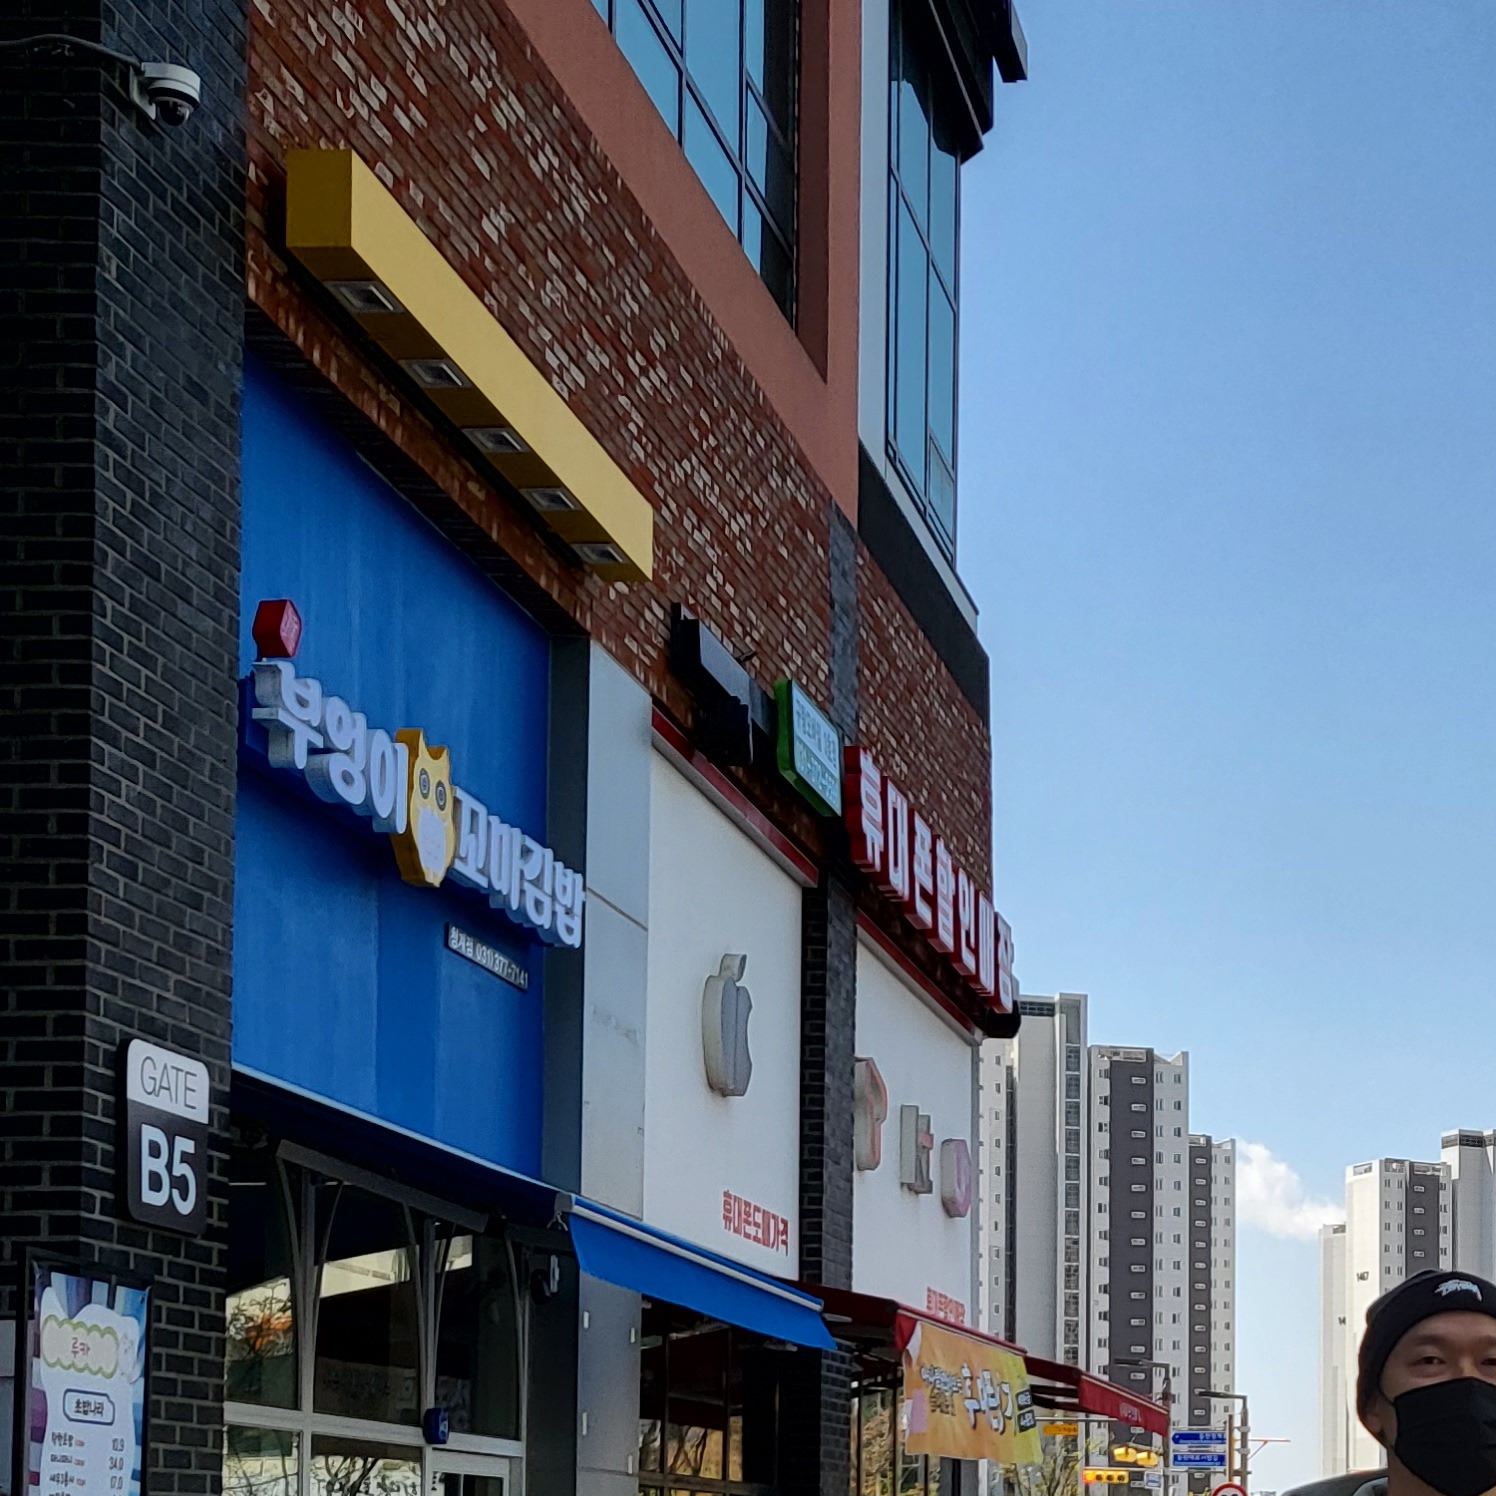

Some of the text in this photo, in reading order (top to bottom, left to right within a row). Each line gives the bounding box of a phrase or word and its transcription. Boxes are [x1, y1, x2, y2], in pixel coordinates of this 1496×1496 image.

[266, 660, 408, 835] 부엉이
[453, 786, 587, 948] 꼬마김밥
[858, 747, 1014, 1014] 휴대폰할인매장
[140, 1055, 198, 1110] GATE
[141, 1123, 197, 1216] B5
